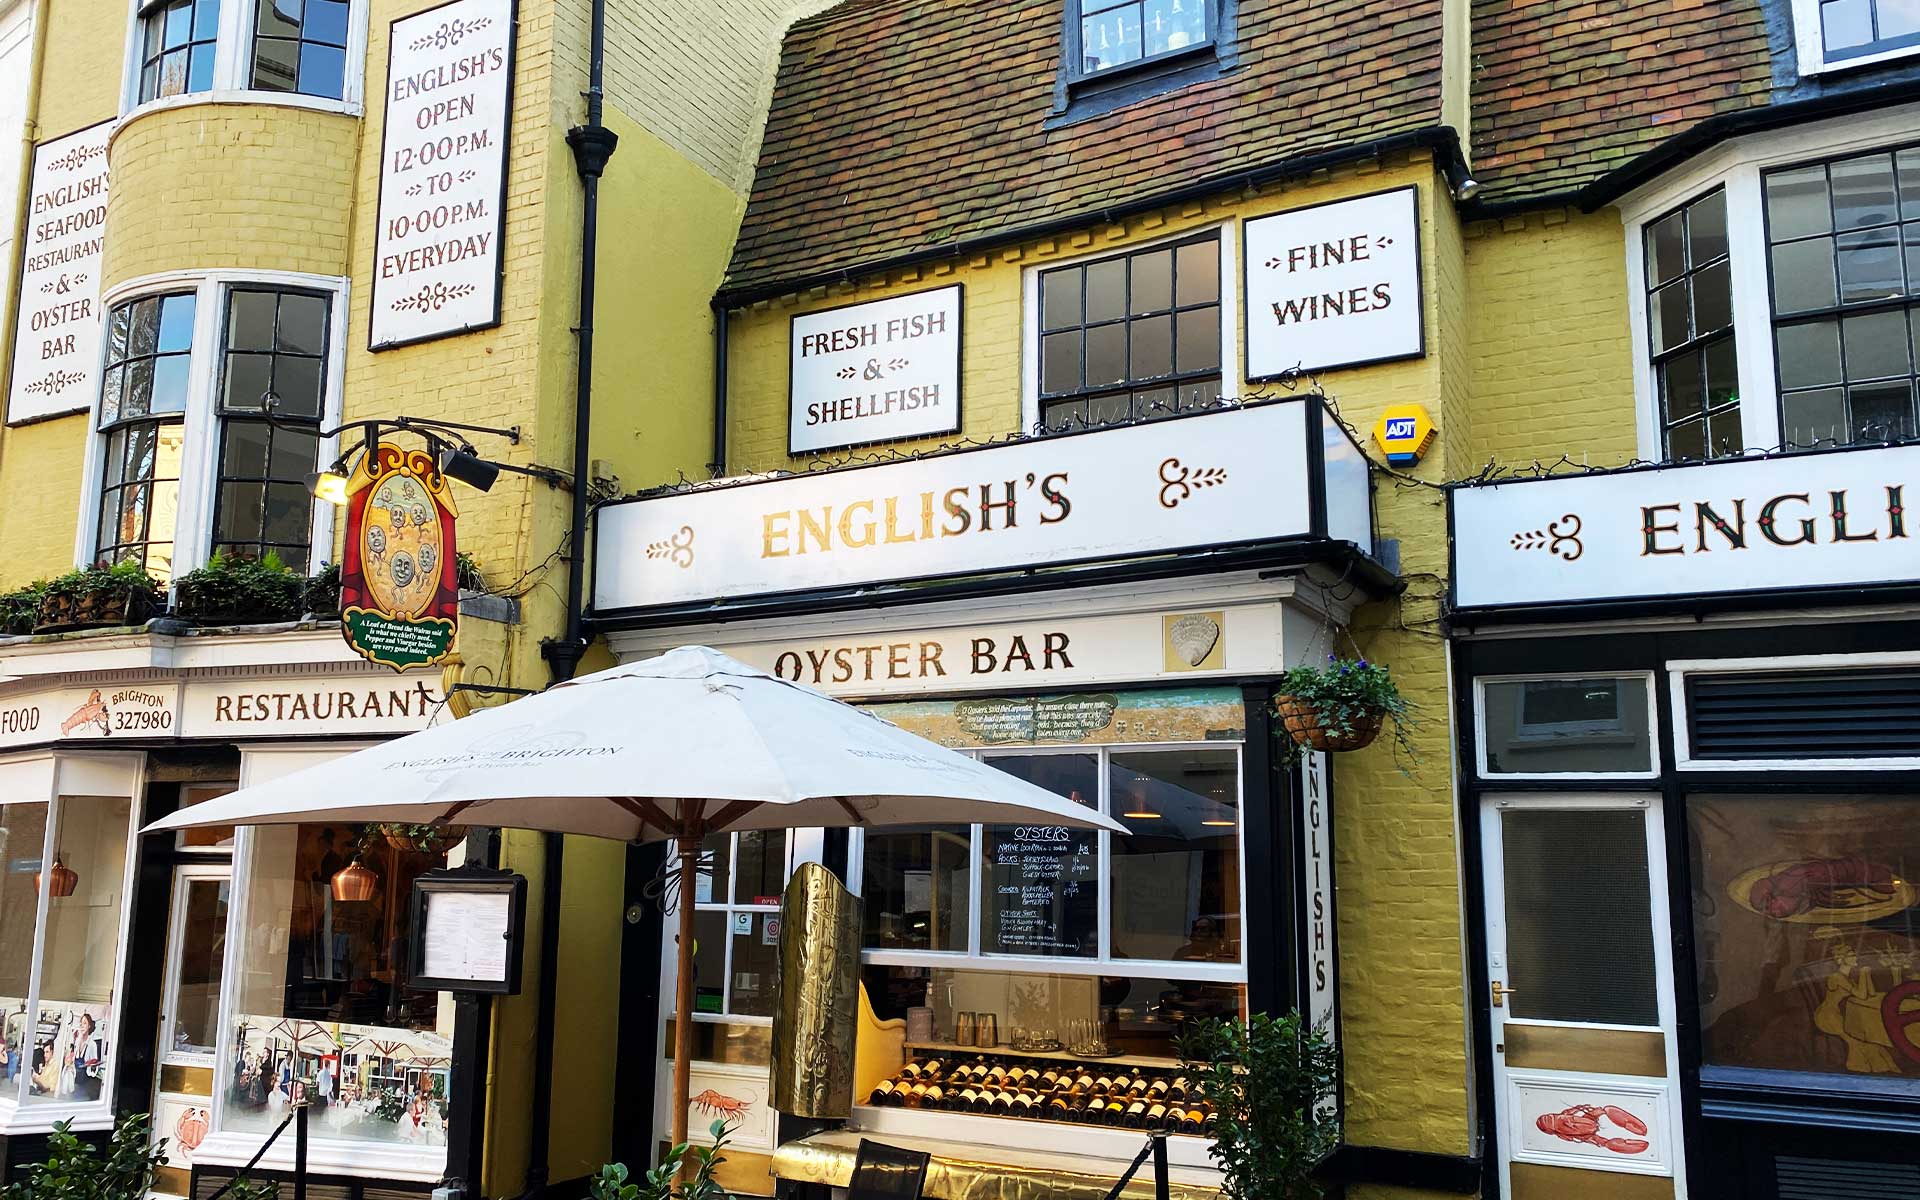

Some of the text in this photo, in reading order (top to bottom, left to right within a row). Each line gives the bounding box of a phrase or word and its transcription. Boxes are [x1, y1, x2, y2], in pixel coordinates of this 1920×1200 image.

[393, 47, 503, 102] ENGLISH'S
[416, 93, 474, 130] OPEN
[427, 172, 453, 195] TO
[36, 205, 107, 244] SEAFOOD
[382, 232, 492, 279] EVERYDAY
[1287, 234, 1370, 273] FINE
[56, 274, 70, 294] &
[31, 298, 91, 331] OYSTER
[1271, 282, 1392, 326] WINES
[41, 334, 75, 360] BAR
[802, 311, 946, 358] FRESH FISH
[864, 358, 884, 380] &
[806, 384, 940, 426] SHELLFISH
[1386, 421, 1416, 437] ADT
[760, 472, 1072, 559] ENGLISH'S
[365, 634, 384, 643] Pepper
[397, 638, 417, 647] Vinegar
[418, 640, 437, 648] besides
[387, 623, 403, 631] Bread
[413, 626, 431, 635] Walrus
[398, 631, 416, 640] chiefly
[774, 632, 1075, 684] OYSTER BAR
[112, 690, 164, 708] BRIGHTON
[215, 688, 434, 722] RESTAURANT
[1, 706, 40, 735] FOOD
[115, 710, 171, 730] 327980
[1014, 826, 1069, 840] OYSTERS
[738, 913, 747, 924] G
